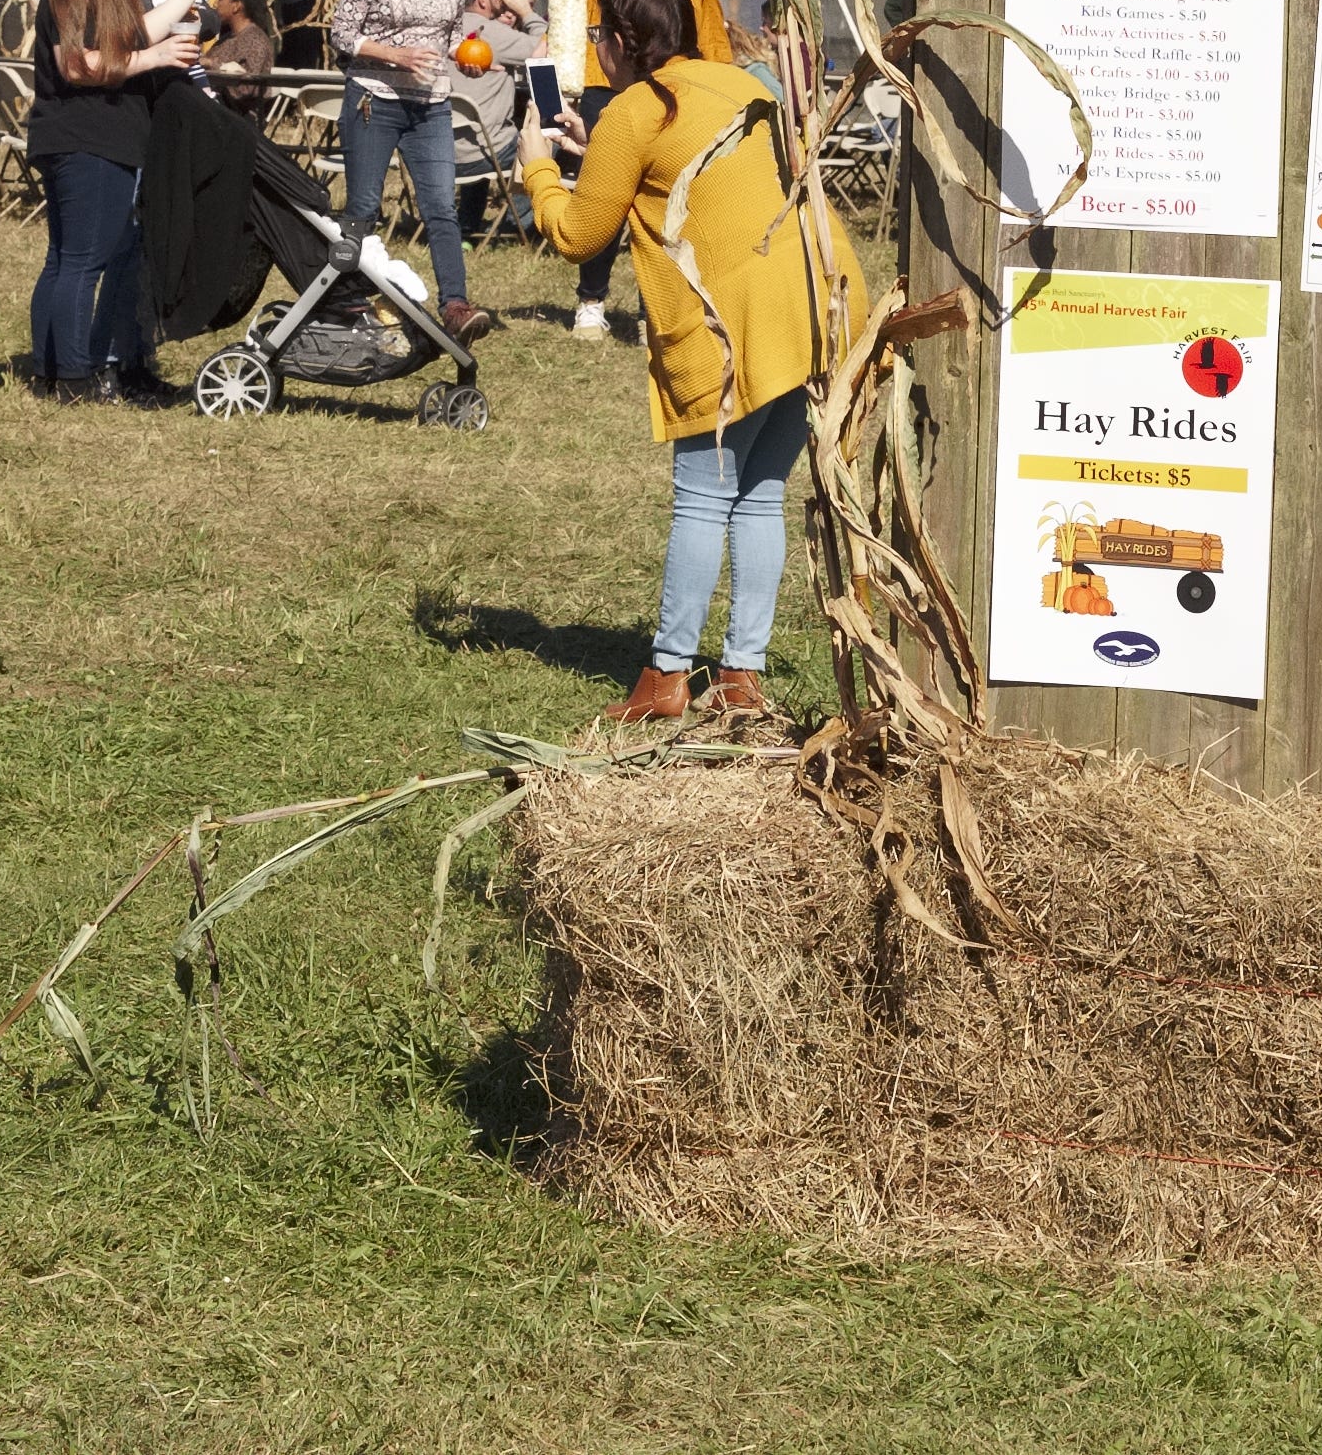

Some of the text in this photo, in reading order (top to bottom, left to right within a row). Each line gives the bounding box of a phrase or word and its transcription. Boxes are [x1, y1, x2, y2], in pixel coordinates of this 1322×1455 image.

[1081, 5, 1111, 19] Kids
[1117, 7, 1165, 21] Games
[1179, 9, 1207, 22] $.50
[1061, 25, 1115, 40] Midway
[1119, 27, 1185, 41] Activities
[1199, 29, 1227, 43] $.50
[1045, 43, 1108, 60] Pumpkin
[1113, 46, 1147, 60] Seed
[1151, 48, 1193, 62] Raffle
[1207, 49, 1241, 63] $1.00
[1064, 65, 1085, 77] ids
[1091, 65, 1133, 79] Crafts
[1145, 67, 1181, 81] $1.00
[1194, 69, 1230, 83] $3.00
[1077, 86, 1119, 101] onkey
[1124, 87, 1171, 103] Bridge
[1185, 89, 1221, 103] $3.00
[1087, 105, 1121, 119] Mud
[1125, 107, 1145, 119] Pit
[1158, 108, 1194, 122] $3.00
[1091, 129, 1107, 142] ay
[1113, 126, 1152, 140] Rides
[1165, 128, 1202, 142] $5.00
[1075, 145, 1109, 162] Pny
[1115, 145, 1155, 160] Rides
[1168, 149, 1205, 163] $5.00
[1115, 167, 1171, 184] Express
[1185, 169, 1221, 183] $5.00
[1081, 195, 1126, 213] Beer
[1145, 199, 1197, 216] $5.00
[1051, 301, 1099, 314] Annual
[1104, 304, 1157, 317] Harvest
[1162, 307, 1187, 319] Fair
[1173, 327, 1253, 365] HARVEST FAIR
[1034, 400, 1237, 445] Hay Rides
[1074, 461, 1191, 487] Tickets: $5
